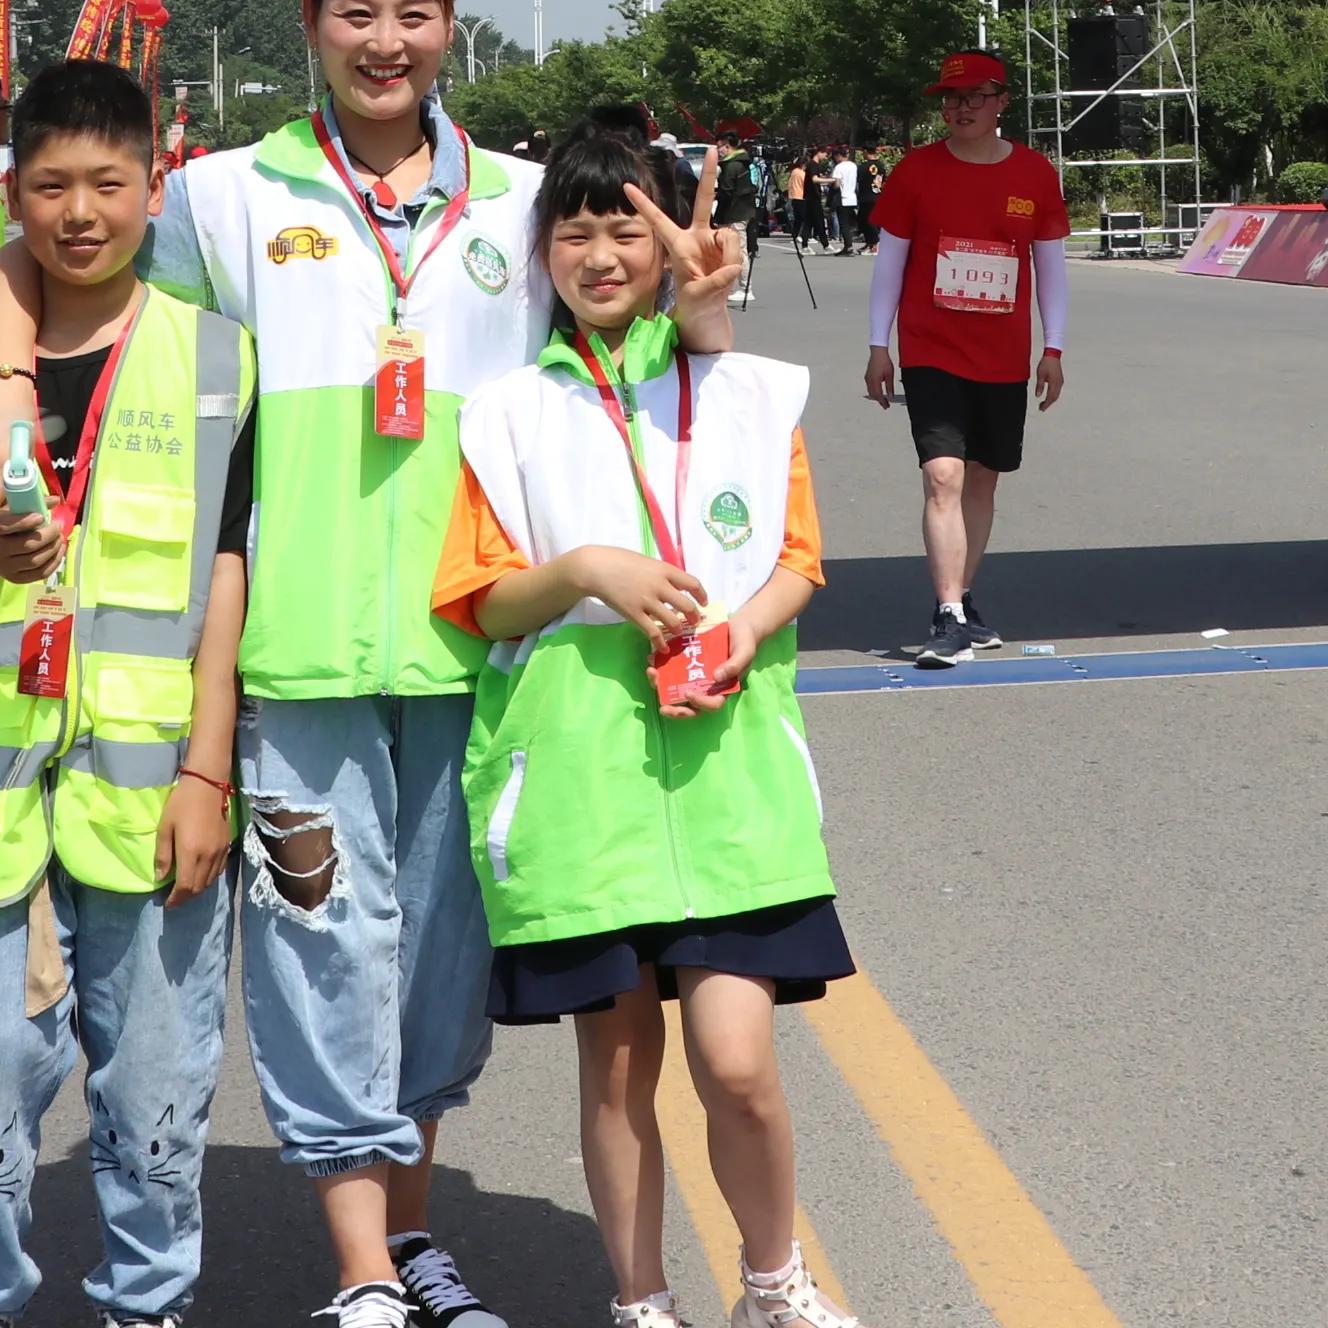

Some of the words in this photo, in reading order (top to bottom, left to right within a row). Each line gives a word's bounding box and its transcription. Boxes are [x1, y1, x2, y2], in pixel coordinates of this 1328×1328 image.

[394, 361, 408, 416] 工作人员
[118, 410, 176, 430] 顺风车
[107, 432, 183, 455] 公益协会
[37, 621, 54, 676] 工作人员
